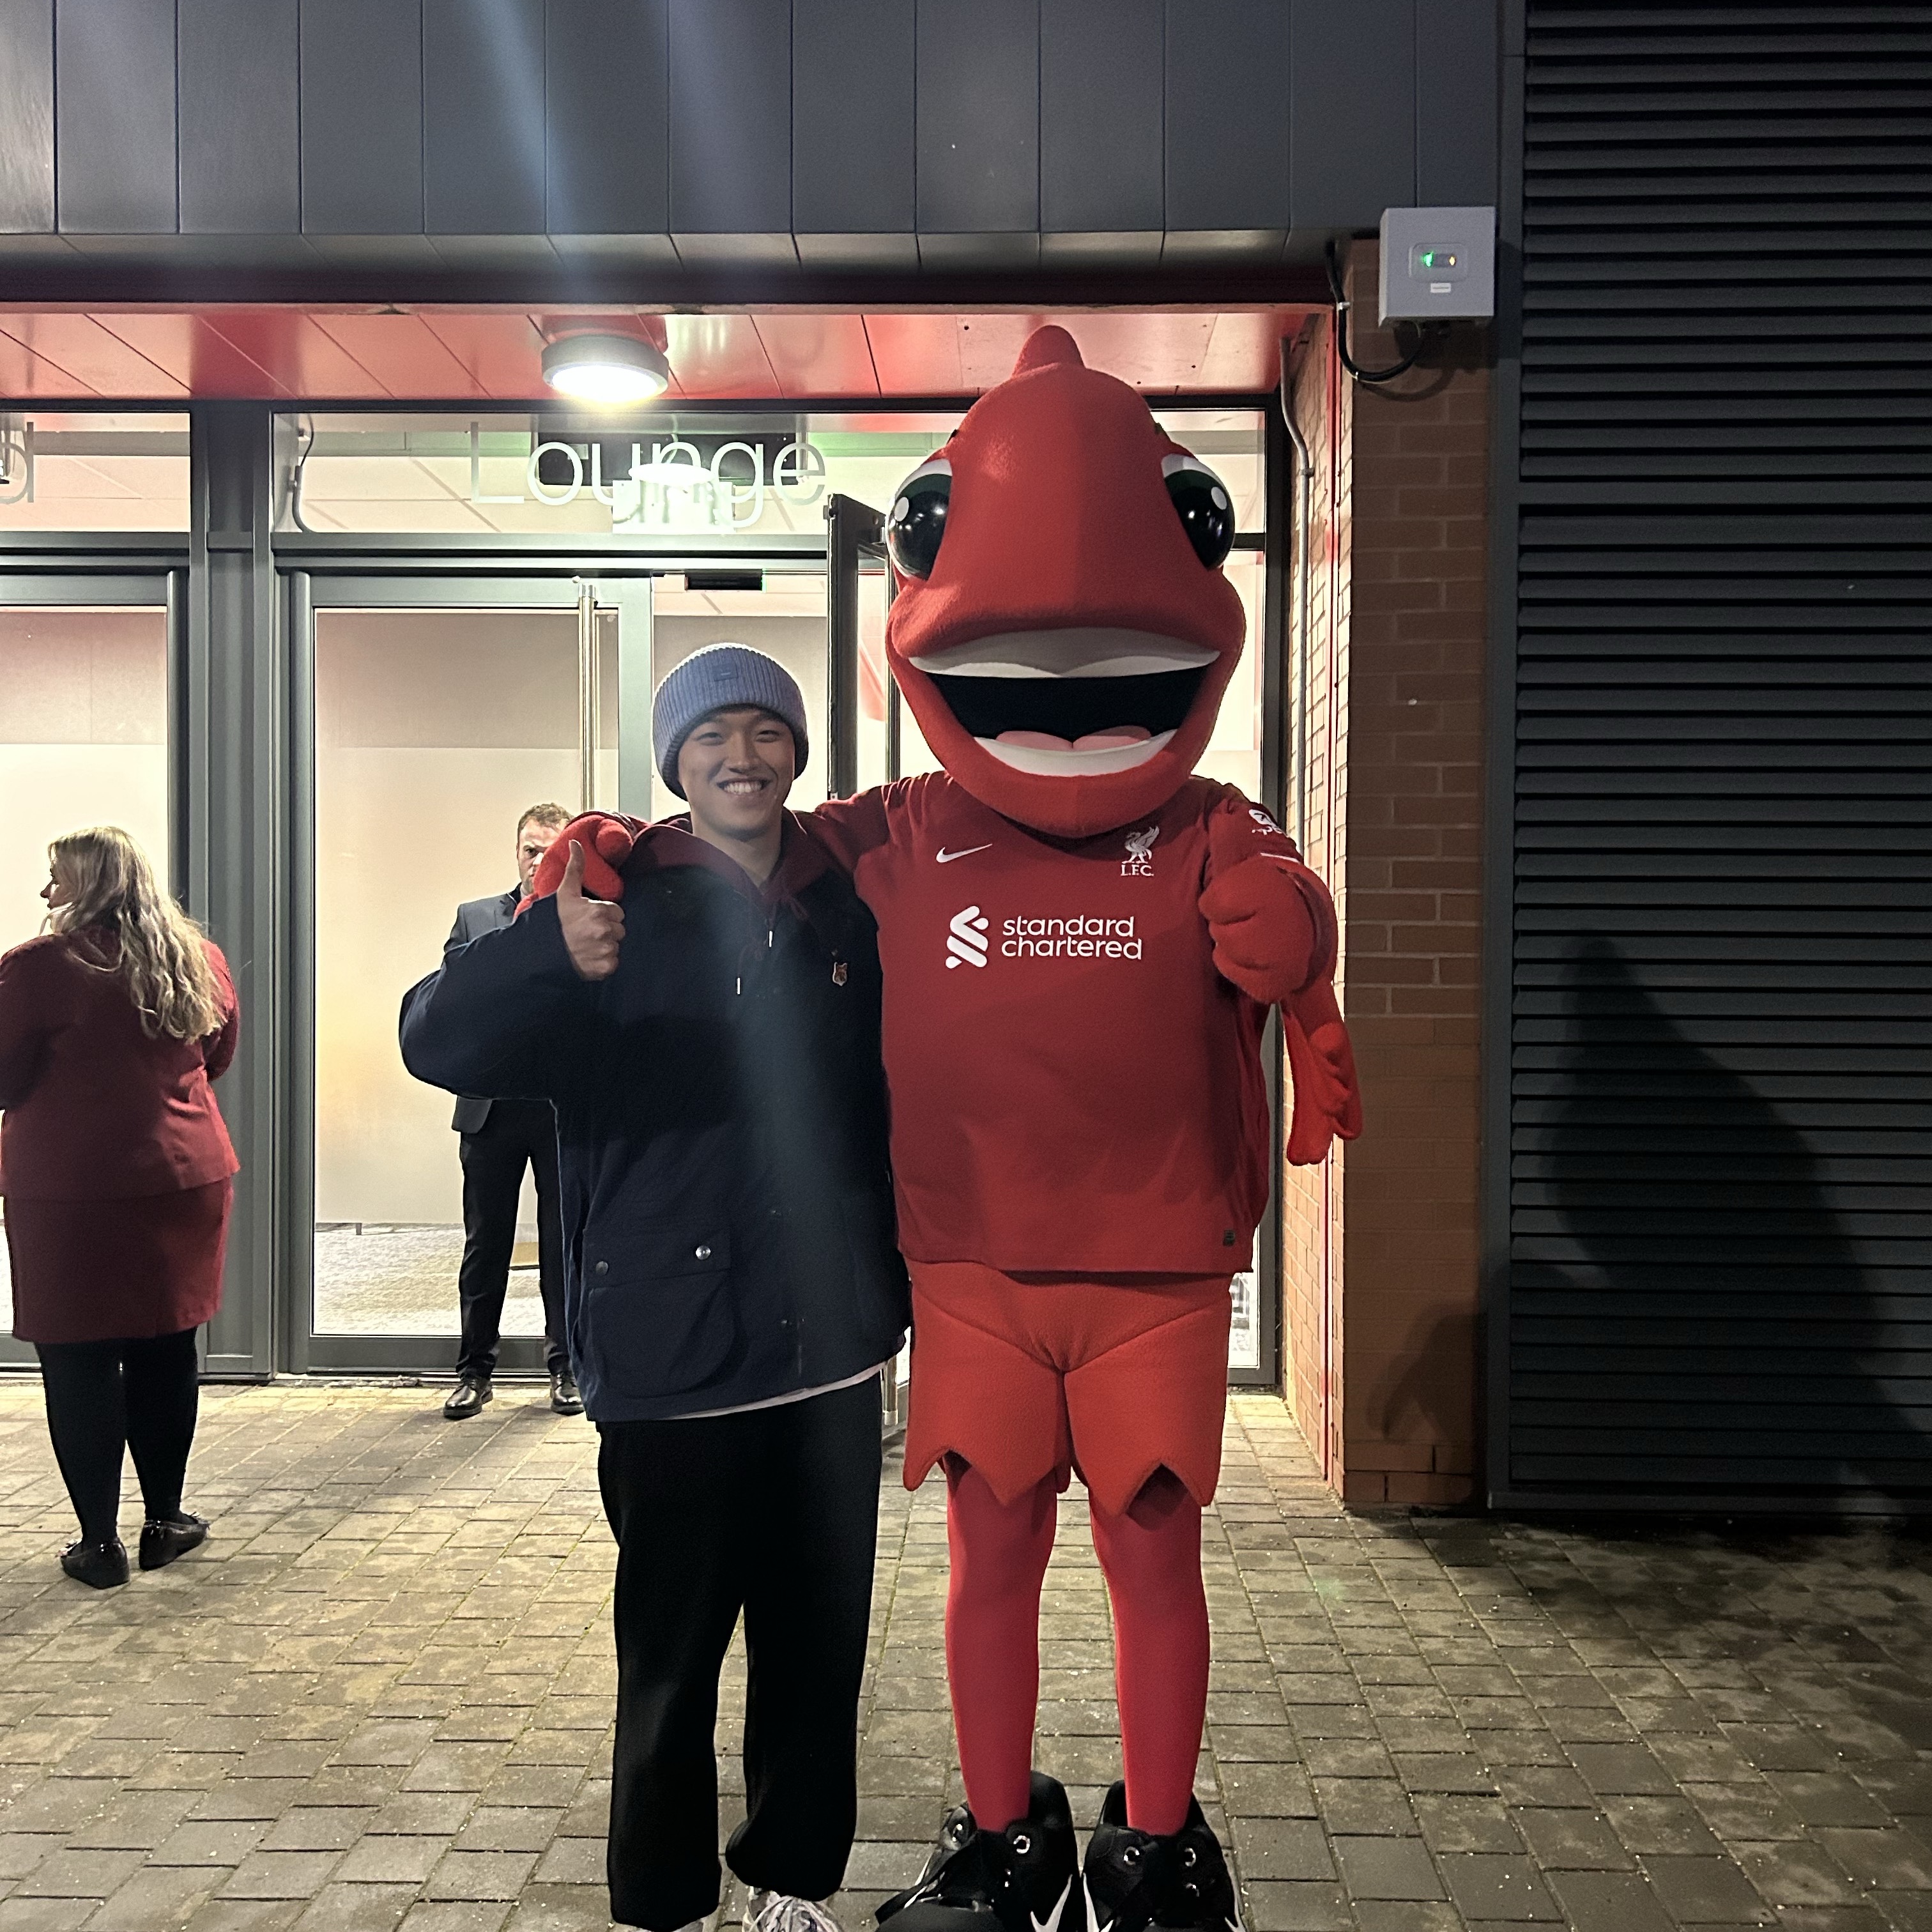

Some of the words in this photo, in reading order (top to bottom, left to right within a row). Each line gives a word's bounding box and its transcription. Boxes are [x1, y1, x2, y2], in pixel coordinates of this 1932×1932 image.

[471, 422, 825, 528] Lounge
[1002, 914, 1135, 937] standard
[1000, 936, 1142, 960] chartered
